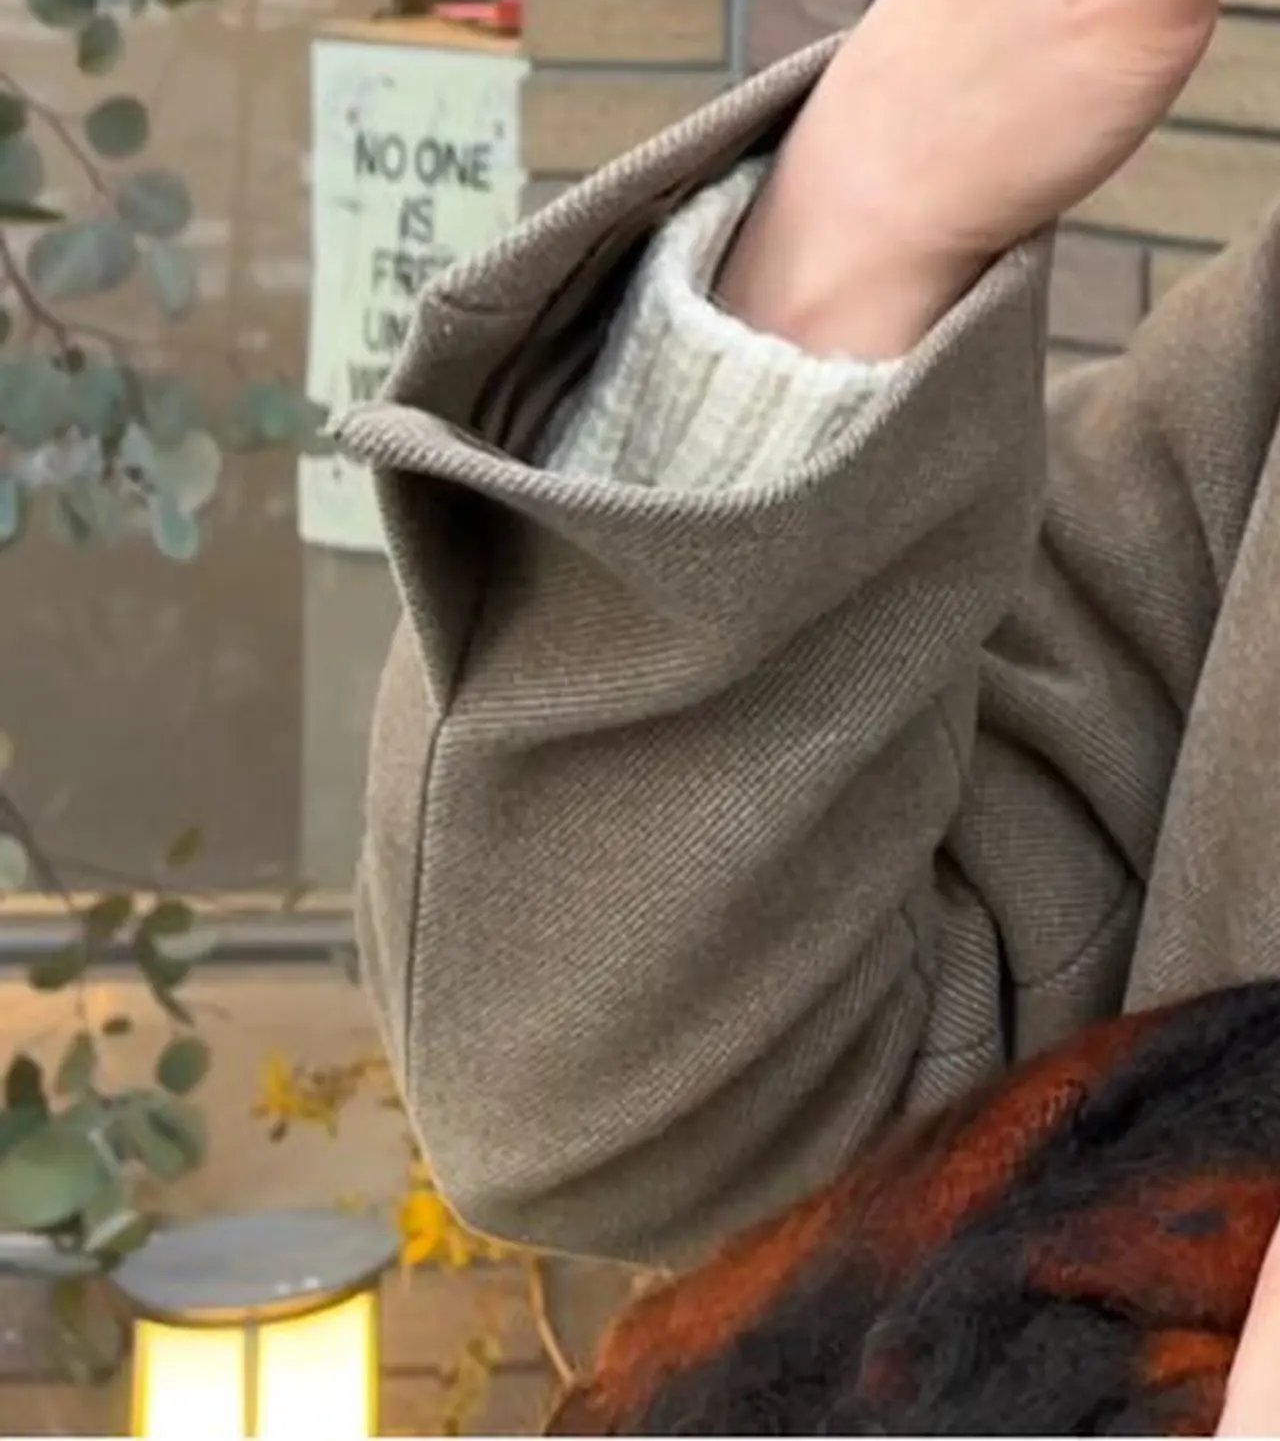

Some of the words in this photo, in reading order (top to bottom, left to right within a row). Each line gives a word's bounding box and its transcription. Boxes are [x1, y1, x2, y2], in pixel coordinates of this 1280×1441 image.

[355, 131, 407, 183] NO
[414, 136, 492, 192] ONE
[400, 196, 433, 243] IS
